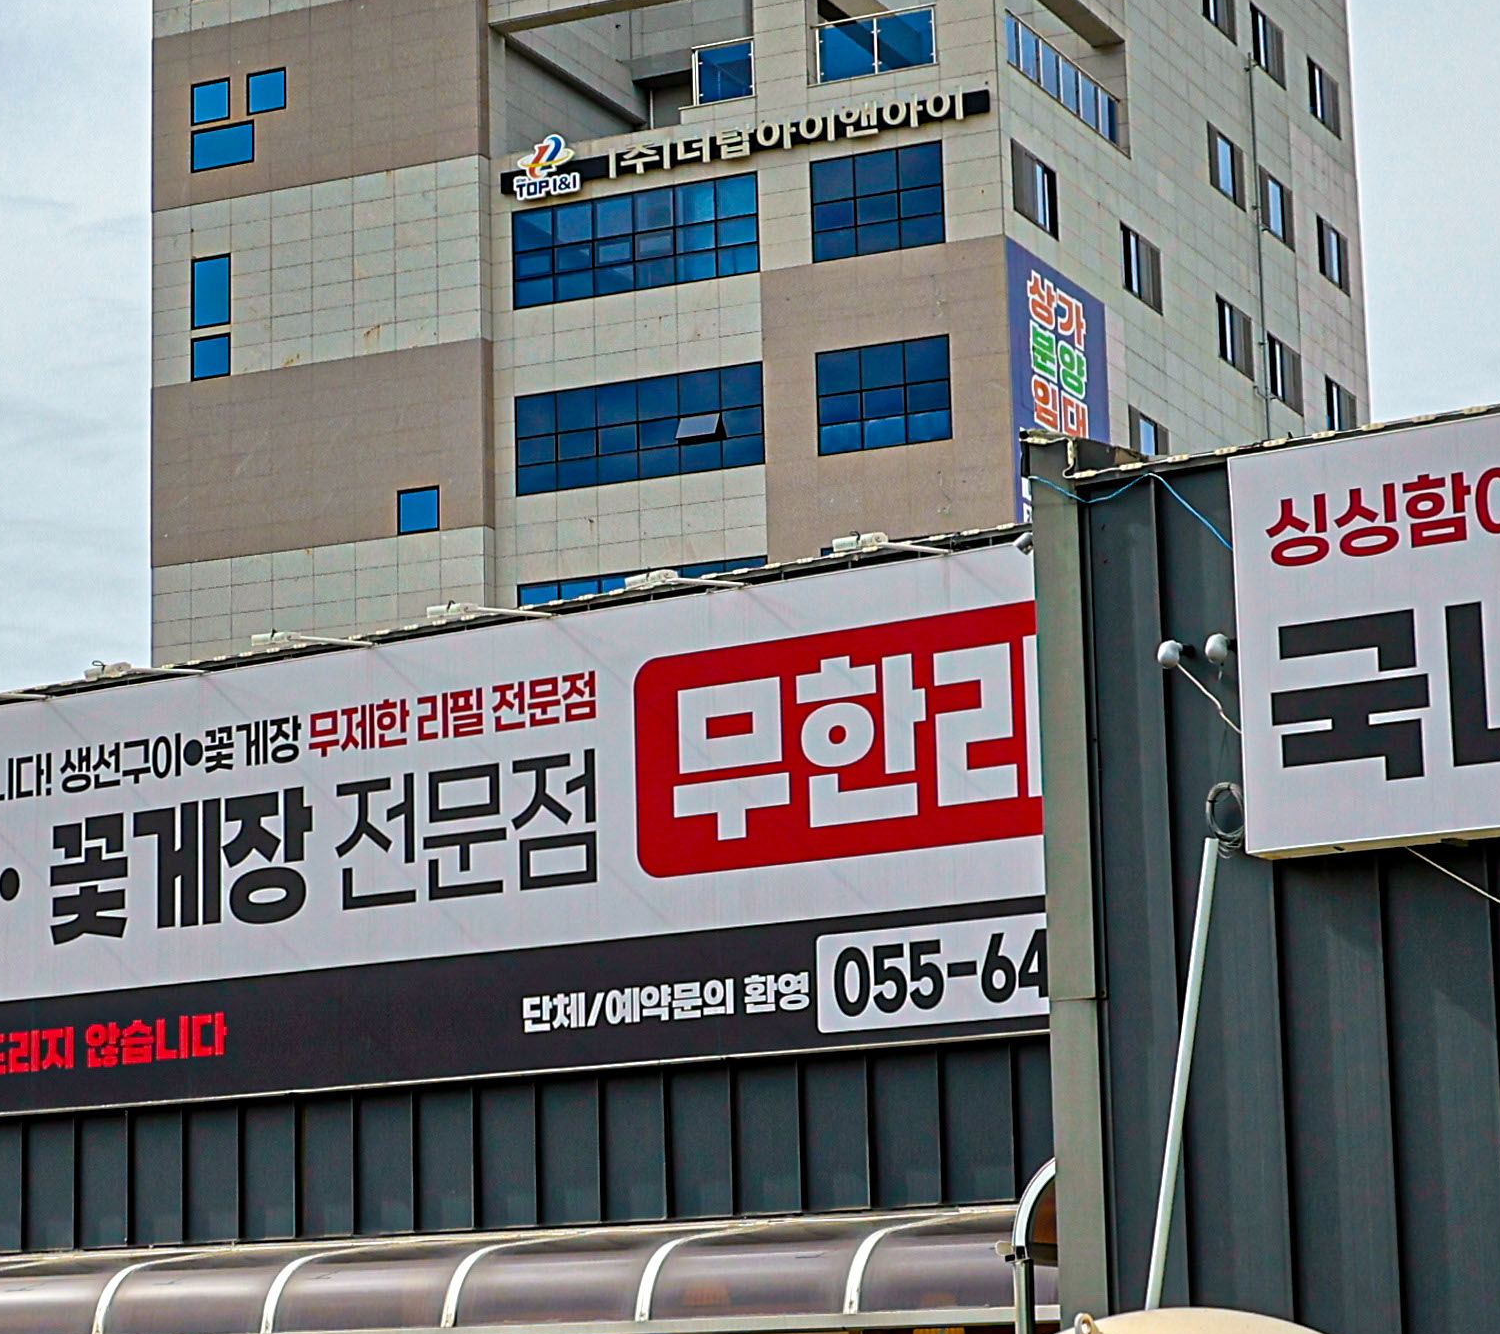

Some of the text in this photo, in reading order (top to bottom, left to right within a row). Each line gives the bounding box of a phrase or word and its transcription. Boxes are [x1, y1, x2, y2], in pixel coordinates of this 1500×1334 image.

[516, 180, 549, 198] TOP
[1028, 271, 1087, 350] 상가
[1029, 321, 1088, 399] 분양
[1032, 375, 1090, 437] 임대
[308, 698, 411, 756] 무제한
[417, 690, 484, 742] 리필
[491, 670, 597, 732] 전문점
[50, 786, 313, 945] 꽃게장
[336, 748, 597, 911] 전문점
[521, 982, 736, 1035] 단체/예약문의
[744, 970, 810, 1017] 환영
[84, 1011, 229, 1069] 않습니다
